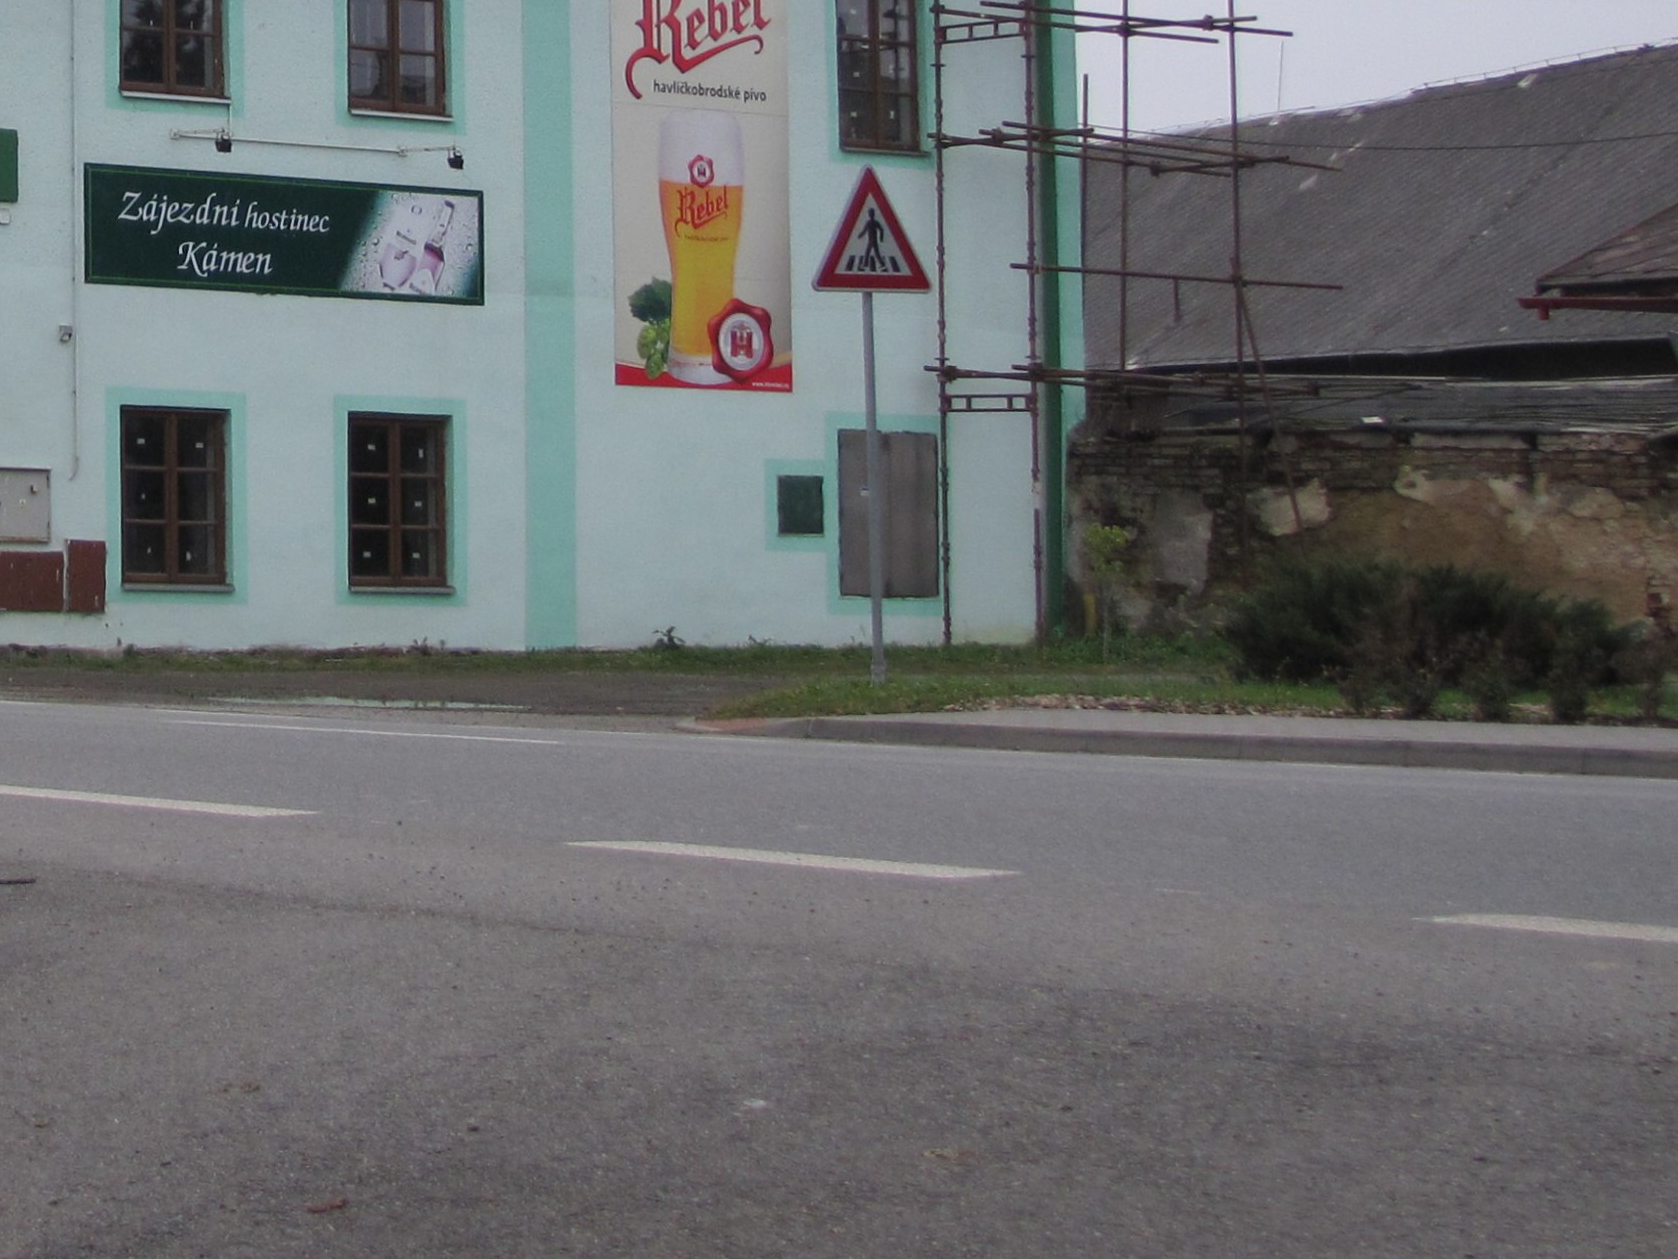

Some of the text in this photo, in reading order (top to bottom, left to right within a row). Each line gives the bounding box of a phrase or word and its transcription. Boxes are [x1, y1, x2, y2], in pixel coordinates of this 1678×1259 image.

[653, 79, 767, 103] havlíčkobrodské pivo
[117, 191, 330, 235] Zájezdní hostinec
[675, 185, 729, 237] Rebel
[177, 241, 273, 278] Kámen
